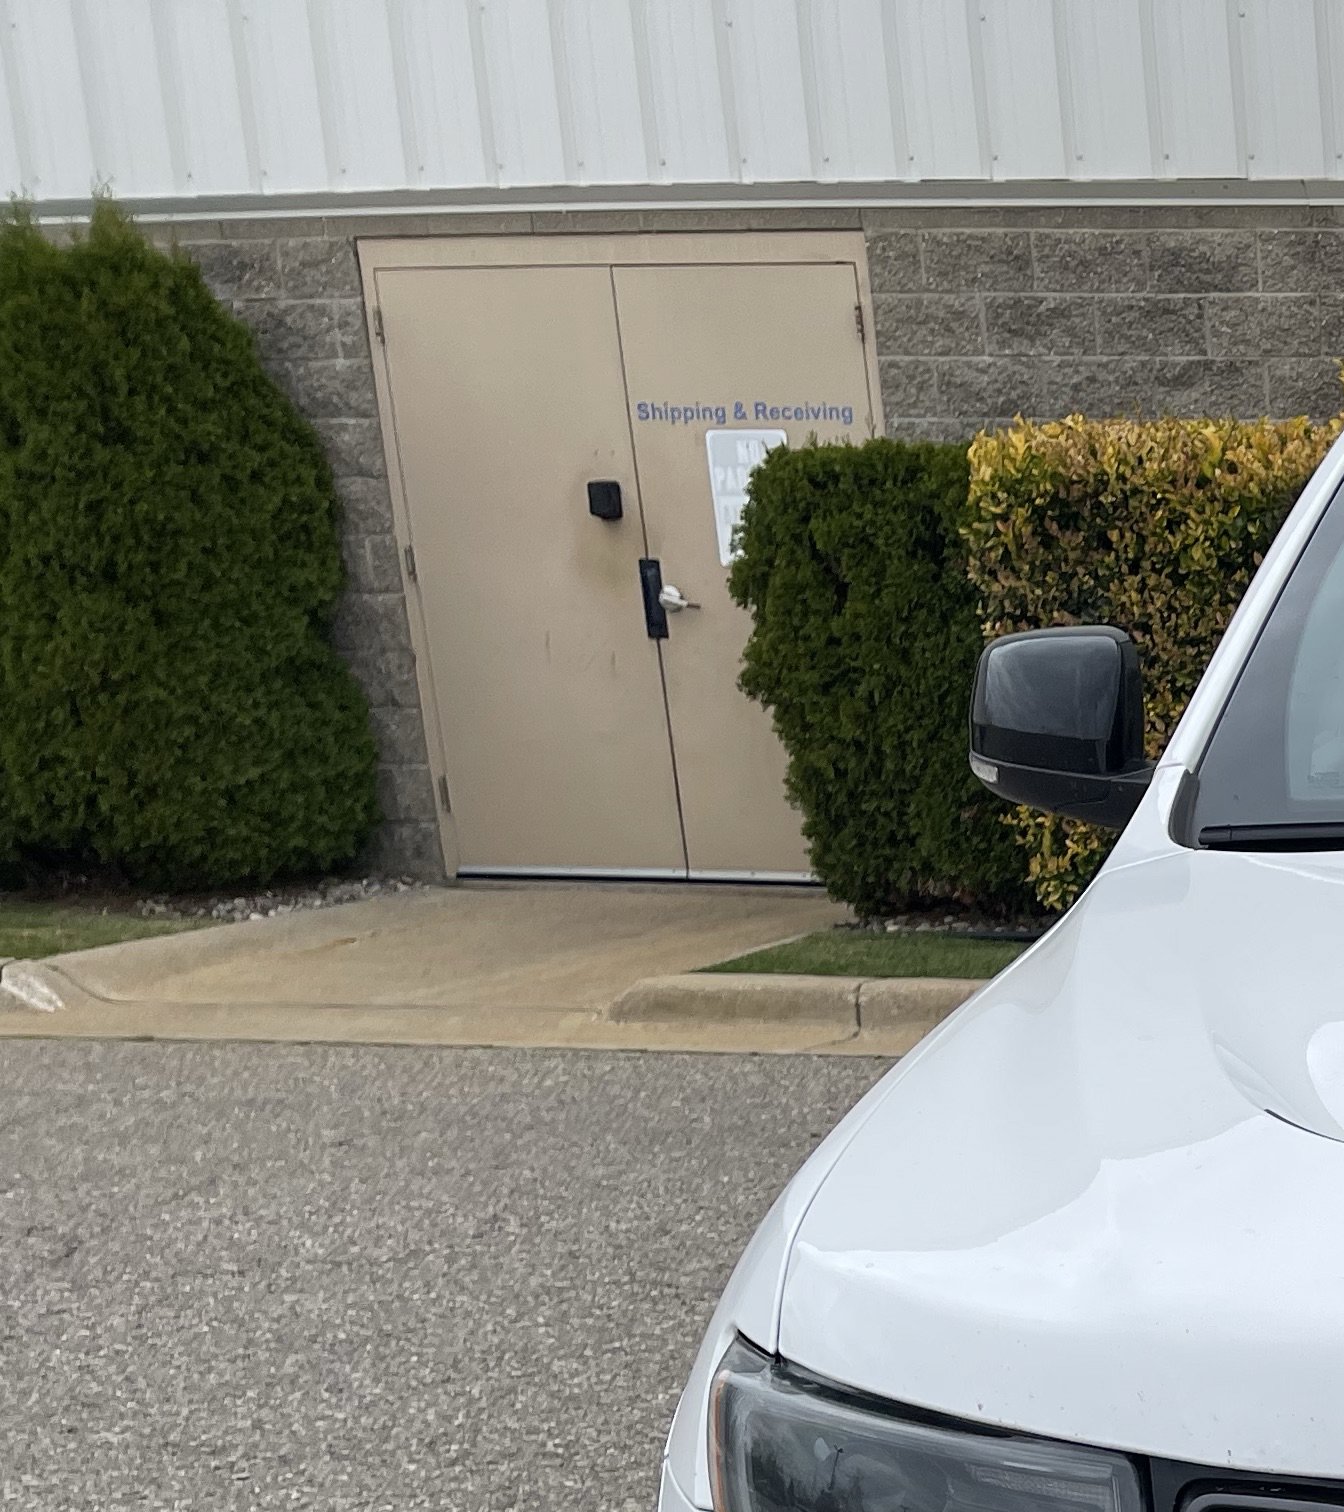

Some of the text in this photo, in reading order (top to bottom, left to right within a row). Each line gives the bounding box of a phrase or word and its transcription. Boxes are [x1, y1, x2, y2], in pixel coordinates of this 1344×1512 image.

[637, 401, 854, 425] Shipping & Receiving
